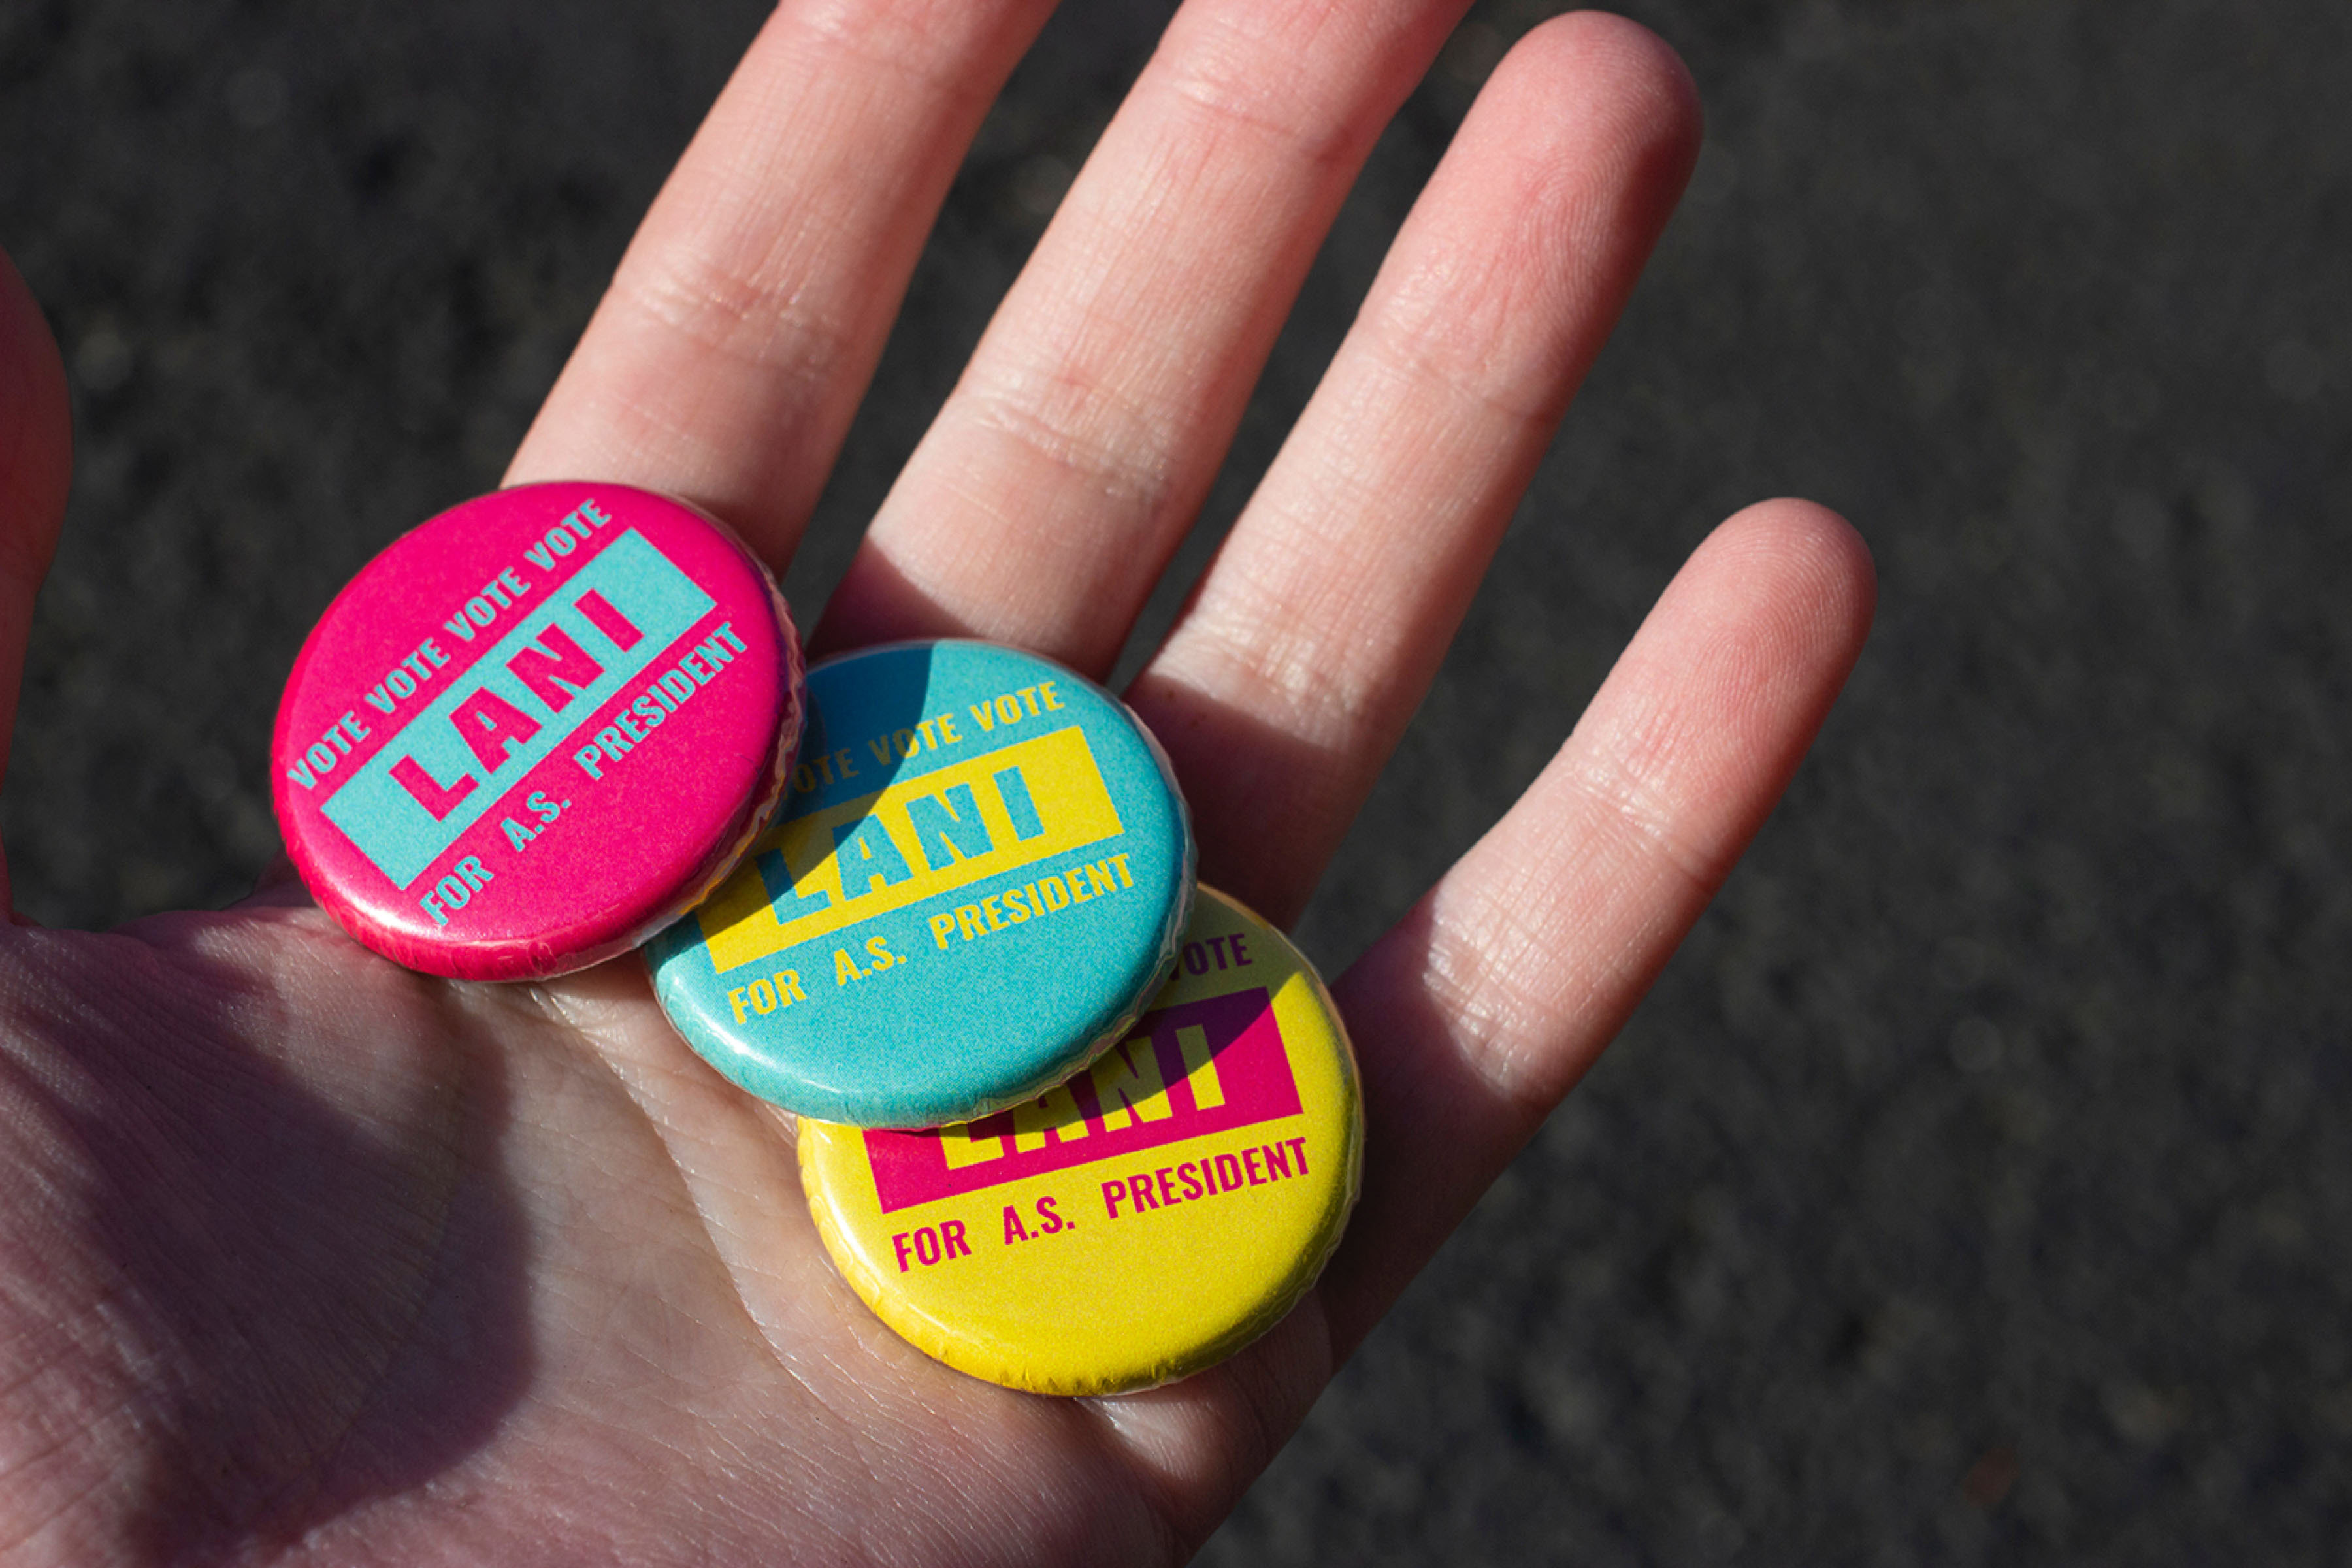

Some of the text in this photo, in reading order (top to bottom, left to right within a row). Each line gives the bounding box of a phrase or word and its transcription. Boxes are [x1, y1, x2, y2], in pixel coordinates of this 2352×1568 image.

[287, 499, 612, 790] VOTE VOTE VOTE VOTE
[389, 587, 645, 822] LANI
[419, 621, 747, 926] FOR A.S. PRESIDENT
[785, 681, 1065, 800] OTE VOTE VOTE
[756, 766, 1045, 925] LANI
[728, 854, 1133, 1025] FOR A.S. PRESIDENT
[1169, 932, 1252, 981] OTE
[892, 1137, 1309, 1273] FOR A.S. PRESIDENT
